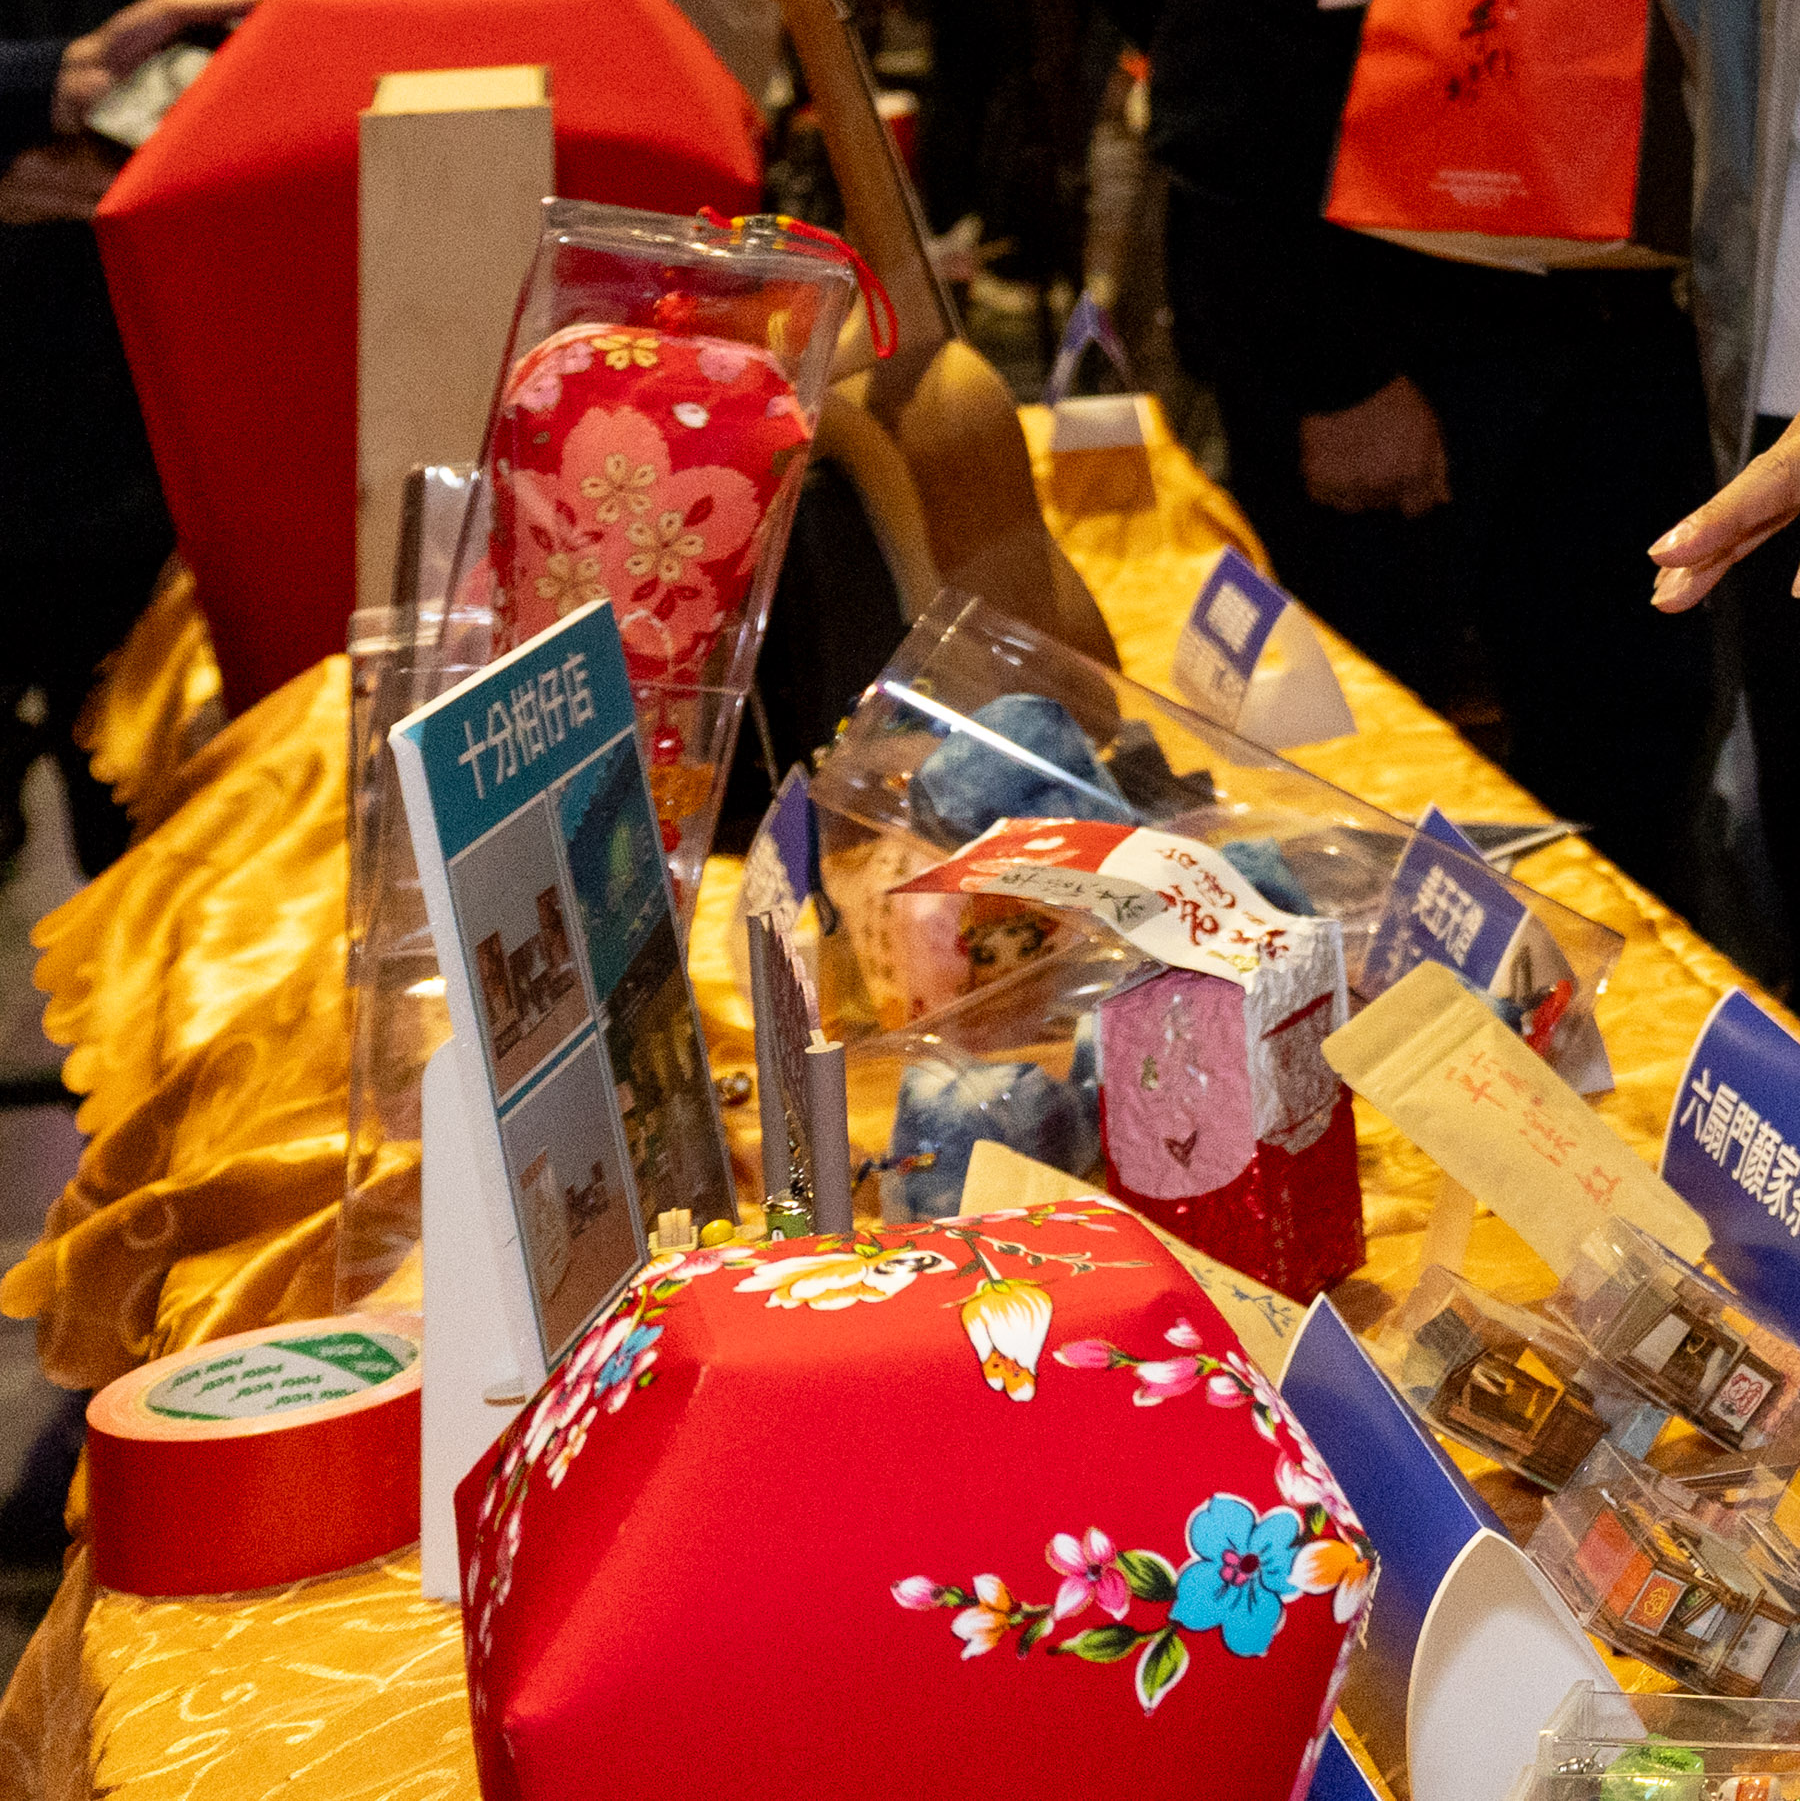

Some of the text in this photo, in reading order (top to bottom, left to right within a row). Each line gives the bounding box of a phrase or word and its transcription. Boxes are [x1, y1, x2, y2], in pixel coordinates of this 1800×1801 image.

[458, 652, 597, 800] 十分柑仔店
